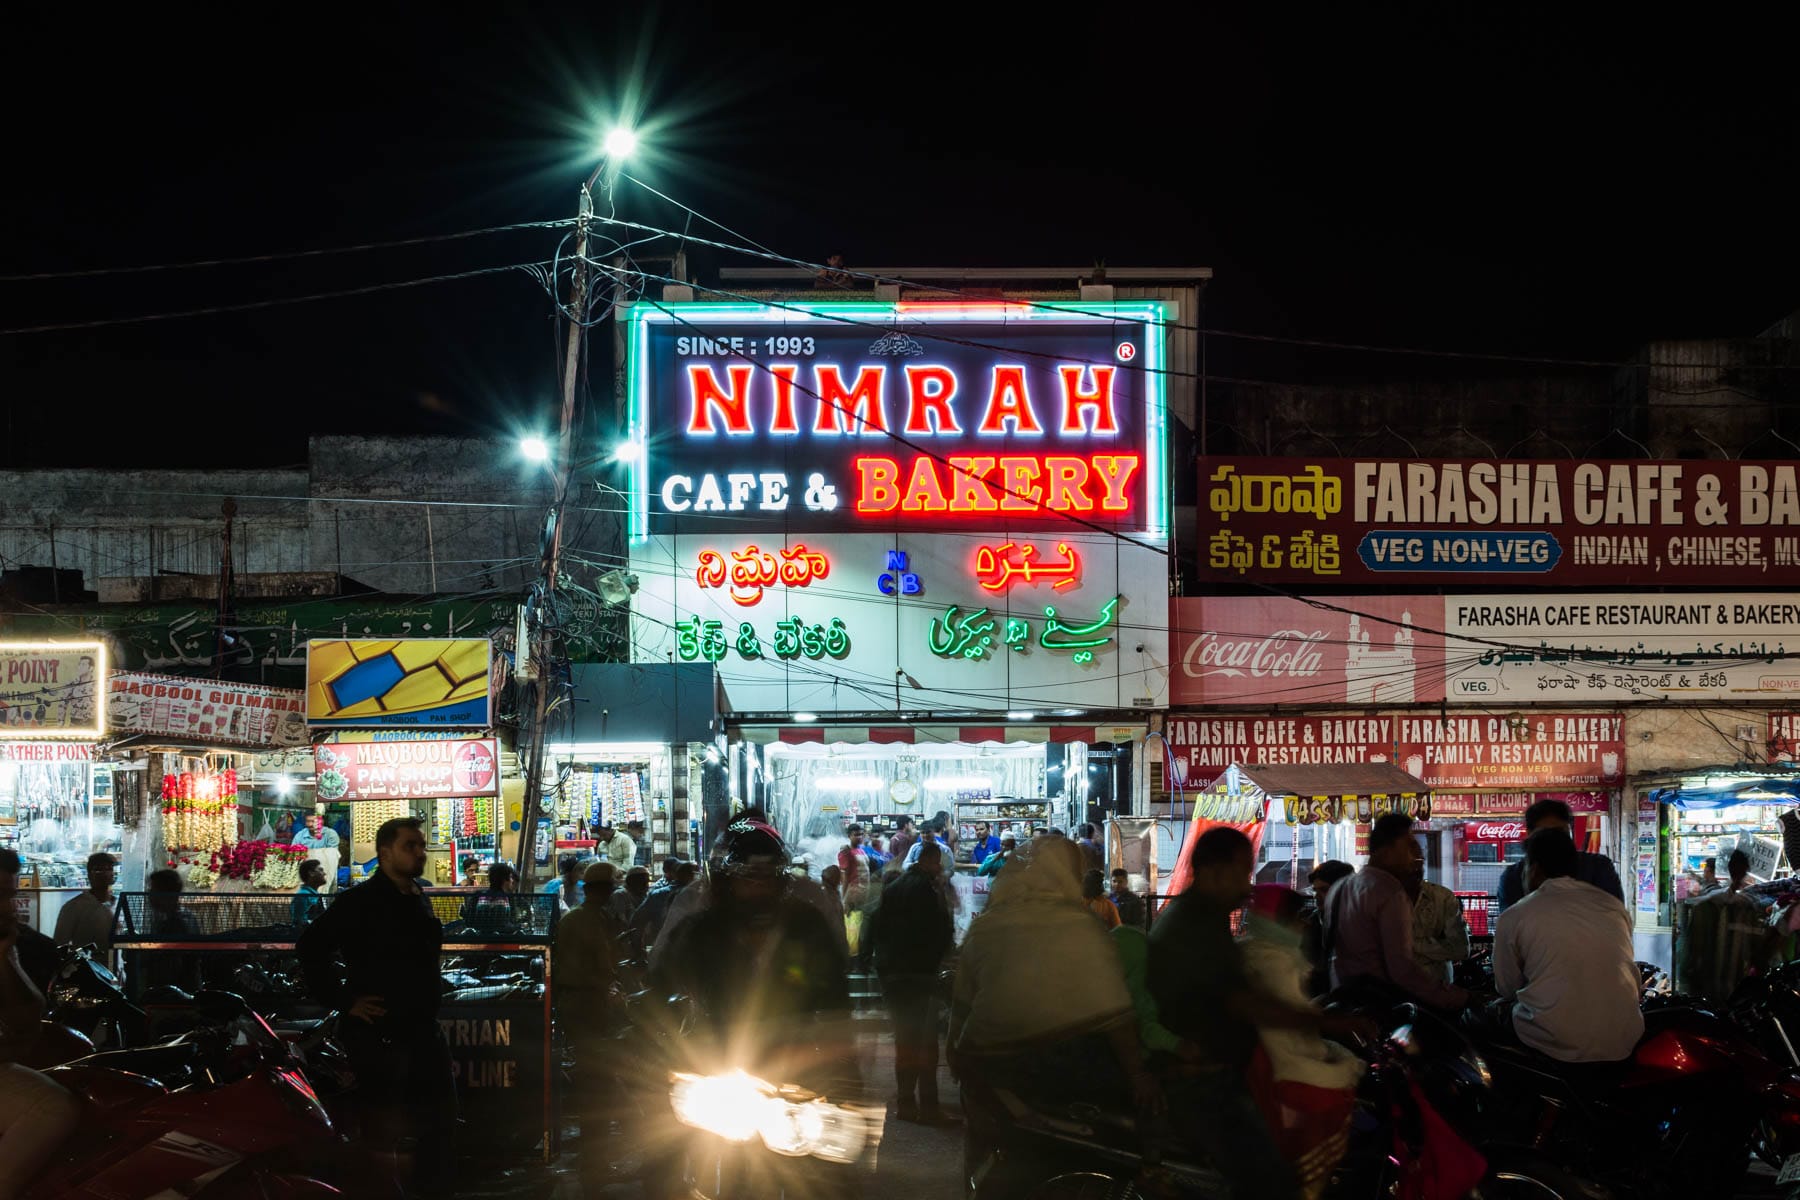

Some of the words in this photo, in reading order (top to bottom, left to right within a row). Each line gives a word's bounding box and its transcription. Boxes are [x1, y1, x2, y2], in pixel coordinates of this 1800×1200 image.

[677, 337, 744, 355] SINCE
[765, 337, 815, 355] 1993
[686, 364, 1120, 436] NIMRAH
[661, 472, 790, 512] CAFE
[804, 472, 839, 512] &
[856, 456, 1139, 513] BAKERY
[1354, 462, 1563, 524] FARASHA
[1573, 463, 1684, 525] CAFE
[1694, 473, 1728, 526] &
[1371, 538, 1423, 563] VEG
[1432, 538, 1549, 563] NON-VEG
[1573, 536, 1648, 565] INDIAN
[1458, 606, 1540, 626] FARASHA
[1545, 606, 1590, 625] CAFE
[1596, 605, 1711, 625] RESTAURANT
[1716, 605, 1728, 624] &
[736, 622, 762, 659] &
[1183, 629, 1331, 678] Coca-Cola
[8, 659, 60, 684] POINT
[1678, 675, 1690, 687] &
[111, 679, 203, 702] MAQBOOL
[1461, 681, 1490, 692] VEG.
[381, 716, 418, 724] MAQBOOL
[430, 714, 446, 722] PAN
[450, 713, 472, 721] SHOP
[373, 731, 417, 742] MAQBOOL
[419, 731, 438, 741] PAN
[1167, 720, 1247, 745] FARASHA
[1254, 719, 1296, 745] CAFE
[1304, 724, 1315, 744] &
[1322, 719, 1390, 744] BAKERY
[1402, 718, 1481, 744] FARASHA
[1536, 722, 1548, 743] &
[1554, 718, 1622, 743] BAKERY
[356, 742, 453, 768] MAQBOOL
[1190, 747, 1250, 766] FAMILY
[1257, 746, 1367, 765] RESTAURANT
[1425, 745, 1484, 764] FAMILY
[1490, 744, 1599, 764] RESTAURANT
[358, 768, 395, 782] PAN
[399, 767, 451, 781] SHOP
[1501, 765, 1524, 774] NON
[1482, 793, 1529, 808] WELCOME
[1477, 823, 1522, 839] Coca-Cola
